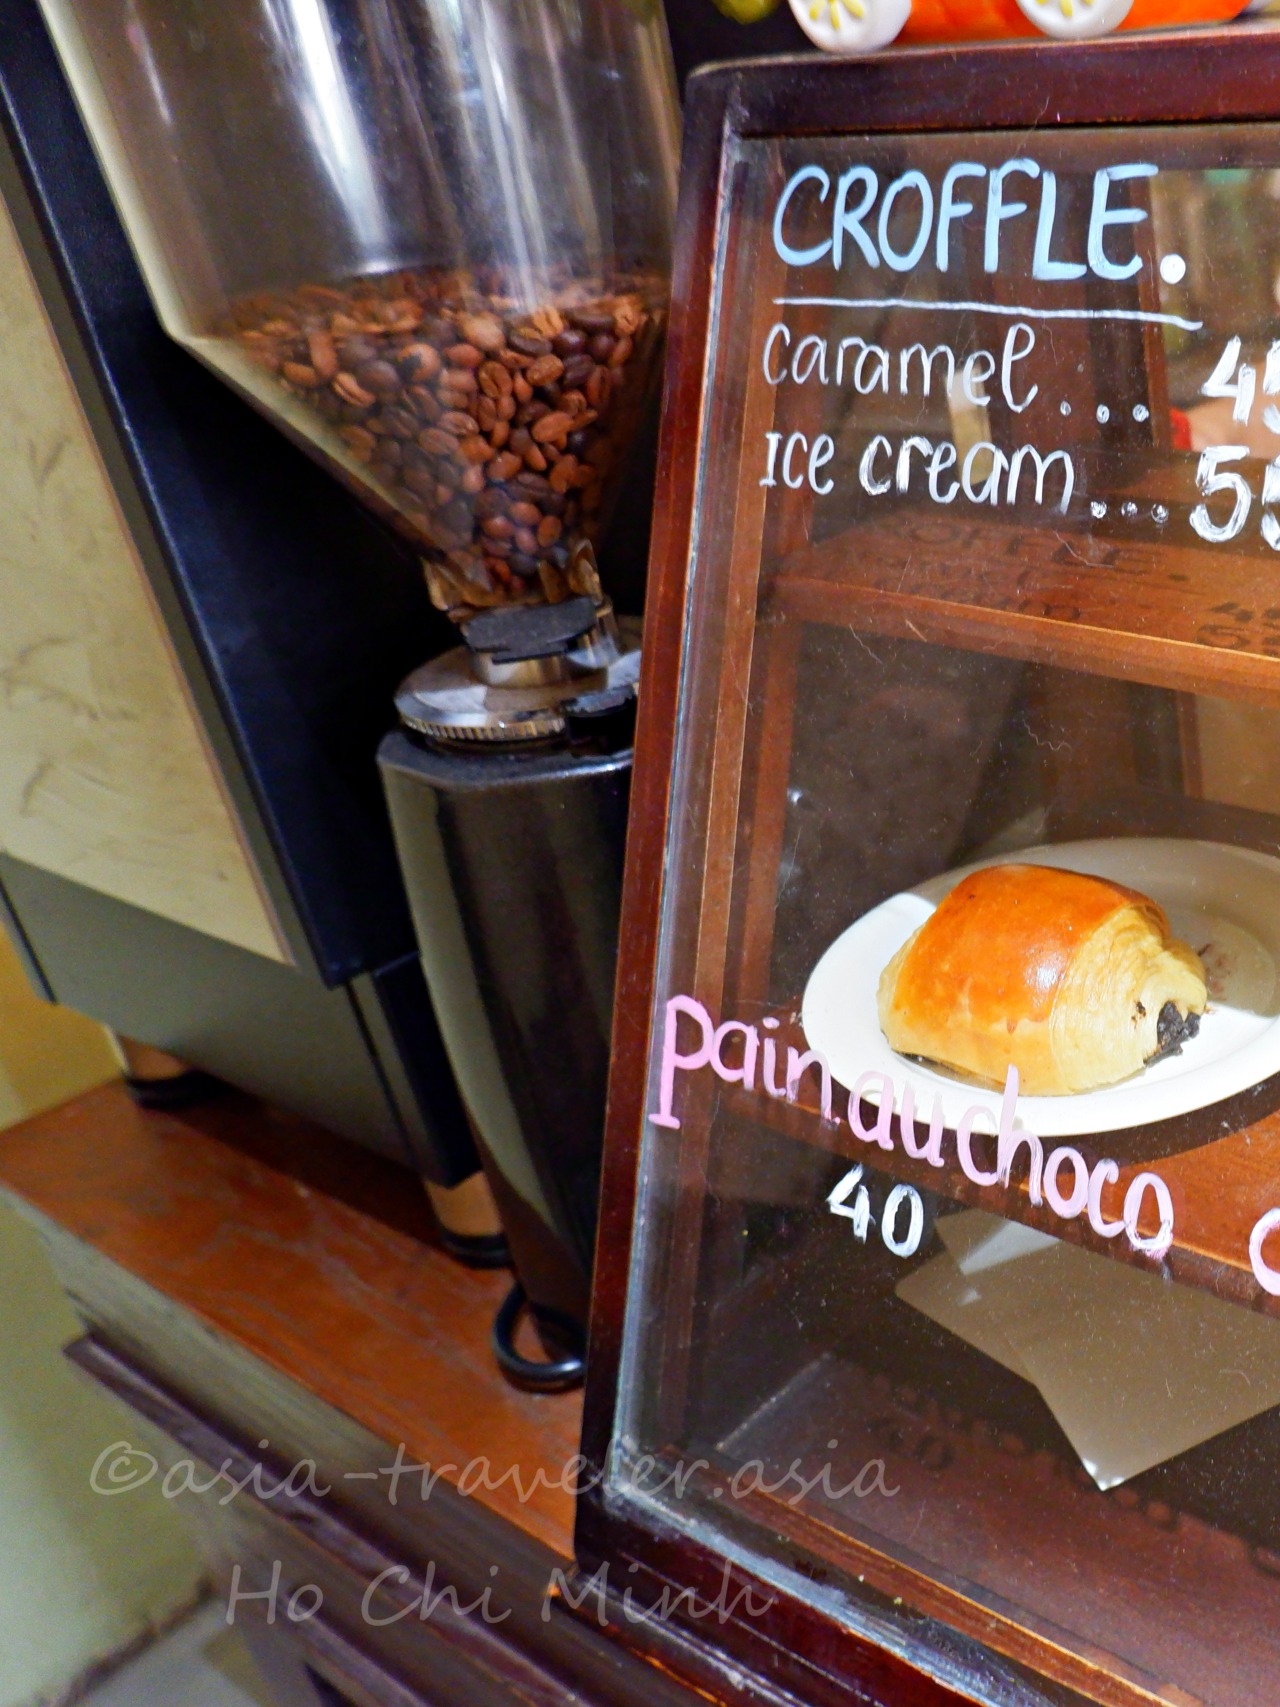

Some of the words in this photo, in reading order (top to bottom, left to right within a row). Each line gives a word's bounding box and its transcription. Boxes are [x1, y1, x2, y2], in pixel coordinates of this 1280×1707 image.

[759, 431, 835, 494] Ice
[859, 435, 1075, 514] cream
[826, 1163, 924, 1258] 40
